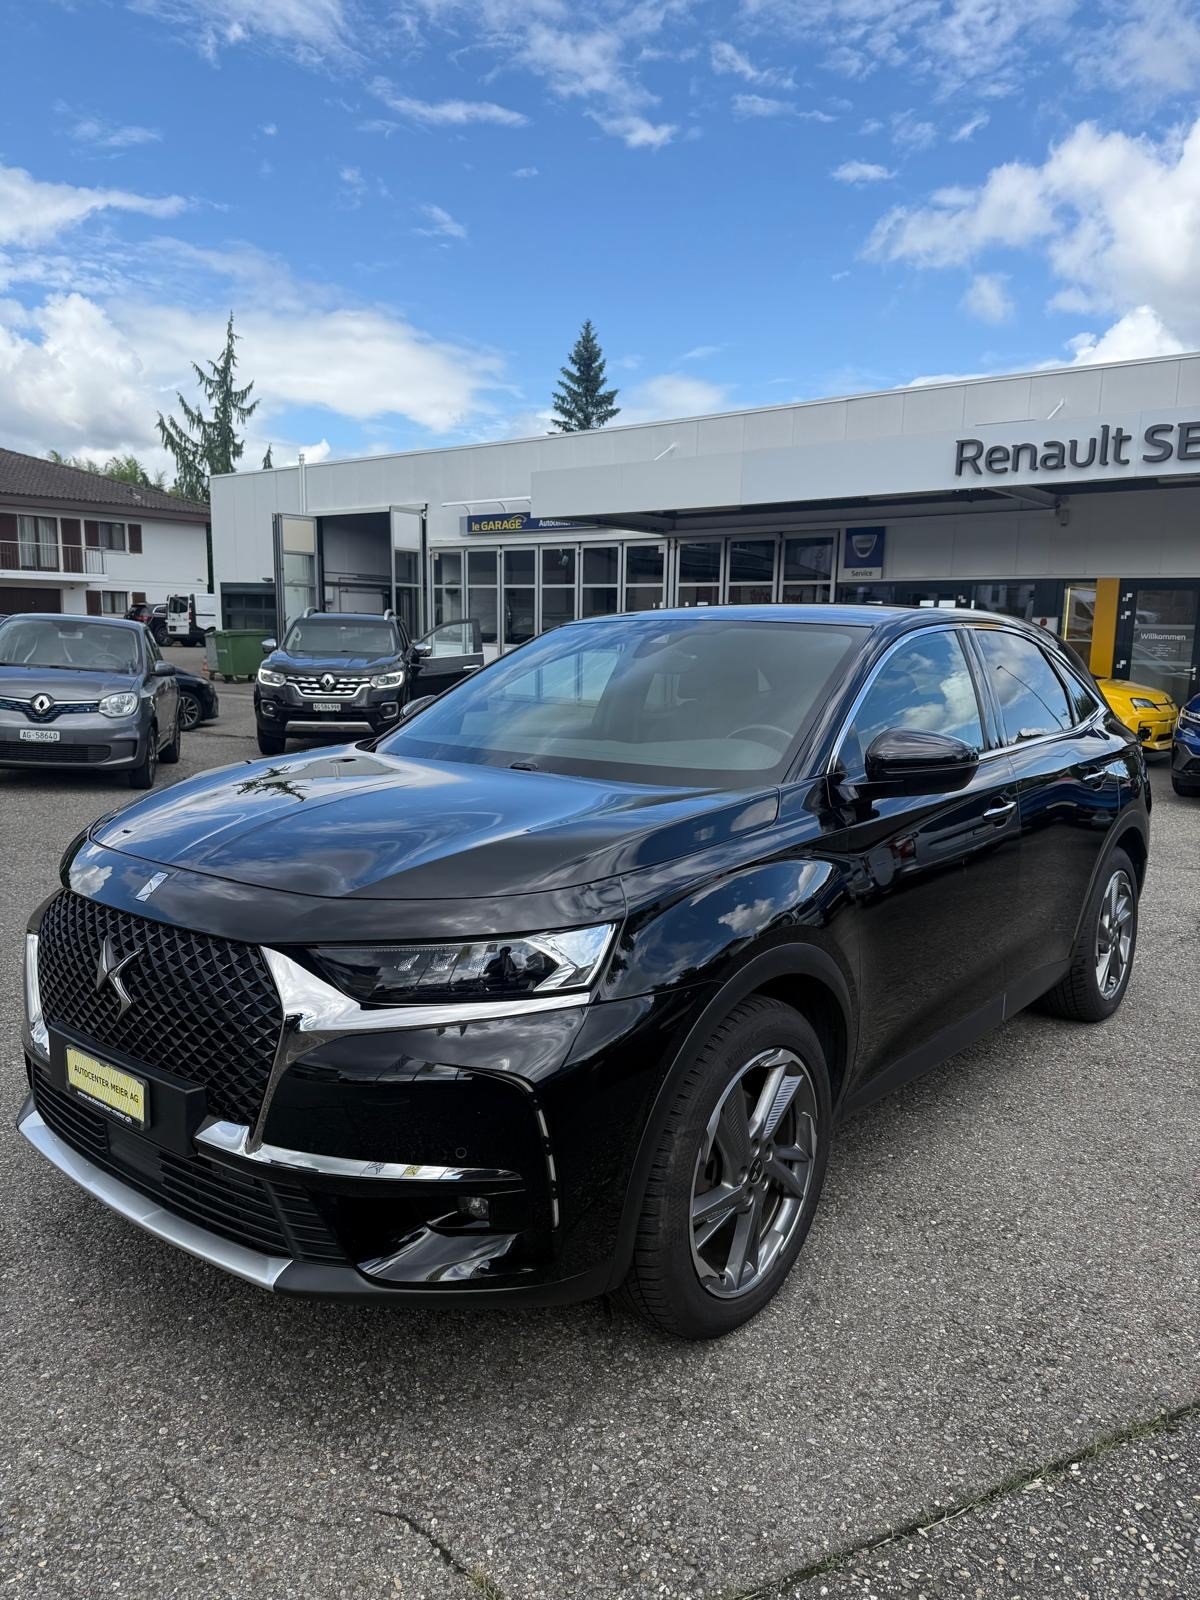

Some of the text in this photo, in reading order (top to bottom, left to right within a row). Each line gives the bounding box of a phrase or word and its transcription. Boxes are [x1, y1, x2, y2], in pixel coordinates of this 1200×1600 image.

[955, 421, 1200, 476] Renault SE
[472, 521, 480, 531] le
[481, 519, 522, 531] GARAGE
[1140, 632, 1186, 641] Willkommen
[74, 1065, 139, 1103] AUTOCENTER MEIER AG
